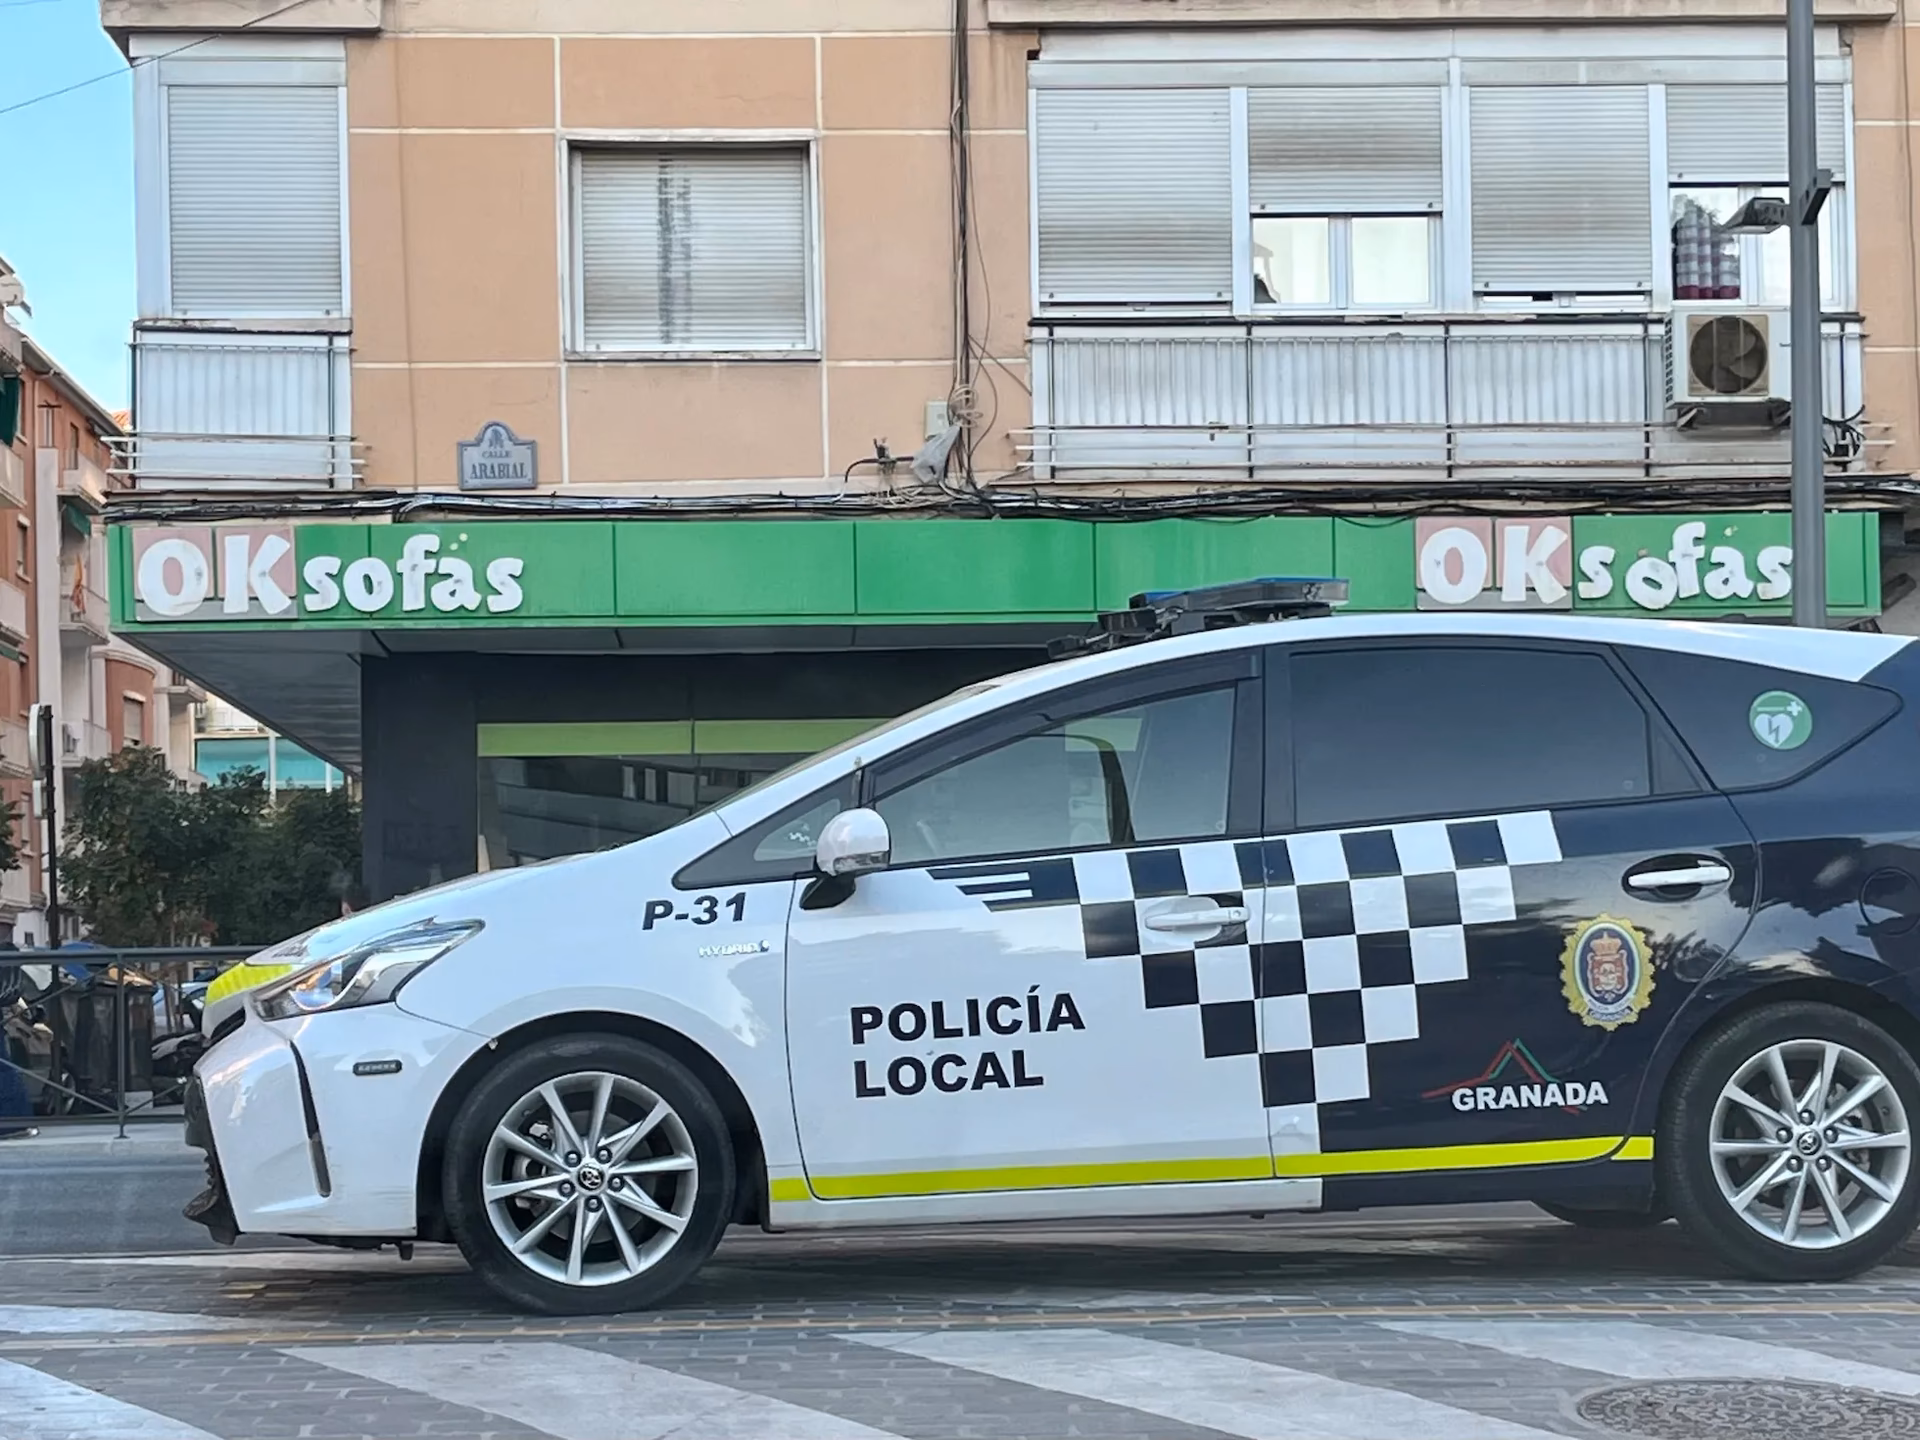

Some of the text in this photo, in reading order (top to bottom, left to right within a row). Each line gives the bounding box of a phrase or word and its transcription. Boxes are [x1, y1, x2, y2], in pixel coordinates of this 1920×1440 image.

[470, 462, 528, 479] ARABIAL
[641, 892, 748, 931] P-31
[850, 985, 1086, 1045] POLICÍA
[853, 1050, 1044, 1098] LOCAL
[1451, 1081, 1609, 1111] GRANADA
